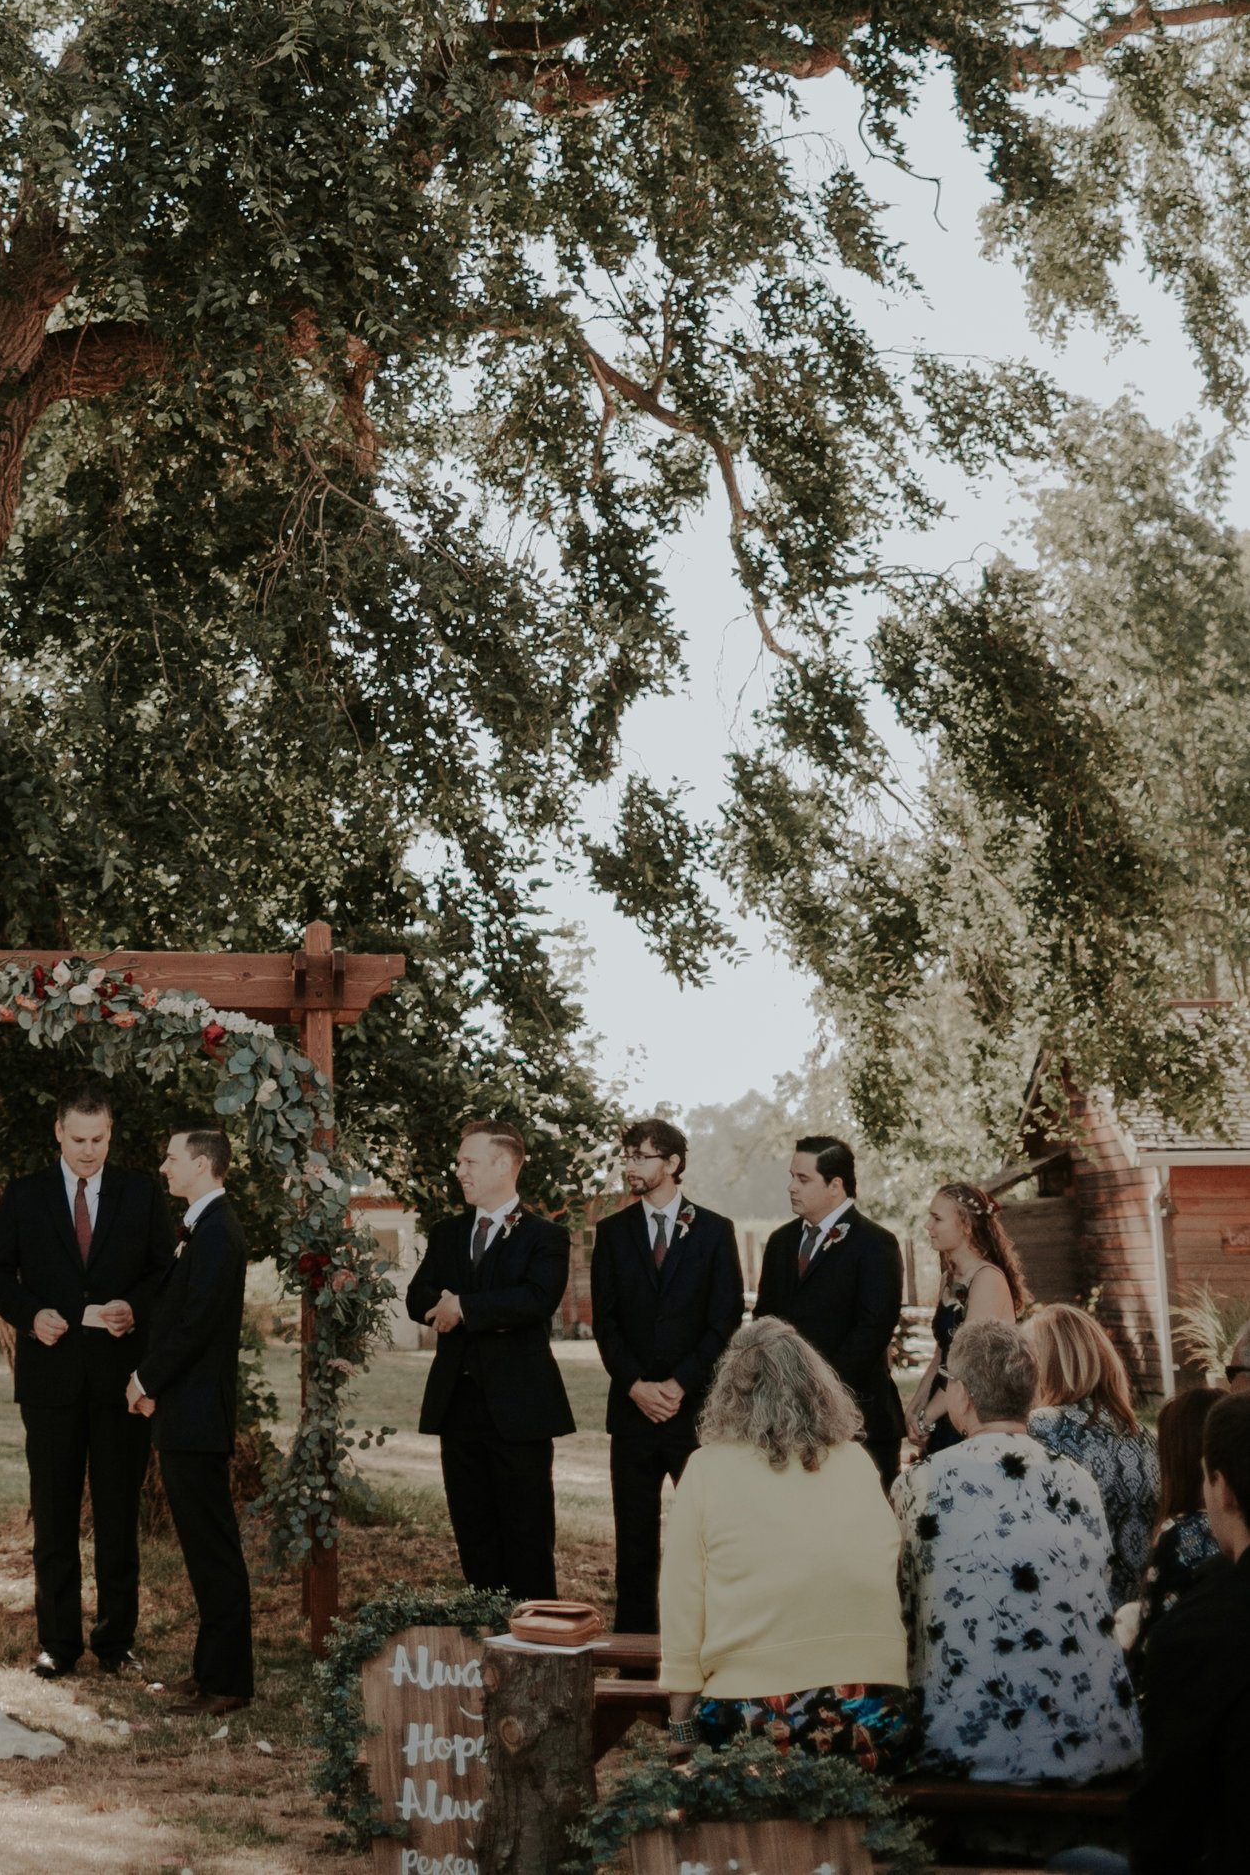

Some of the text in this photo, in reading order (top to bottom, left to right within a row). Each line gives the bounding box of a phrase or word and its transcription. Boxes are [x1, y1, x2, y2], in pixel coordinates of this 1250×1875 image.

[387, 1643, 483, 1720] Alwa
[401, 1722, 488, 1776] Hope
[395, 1776, 483, 1850] Alw
